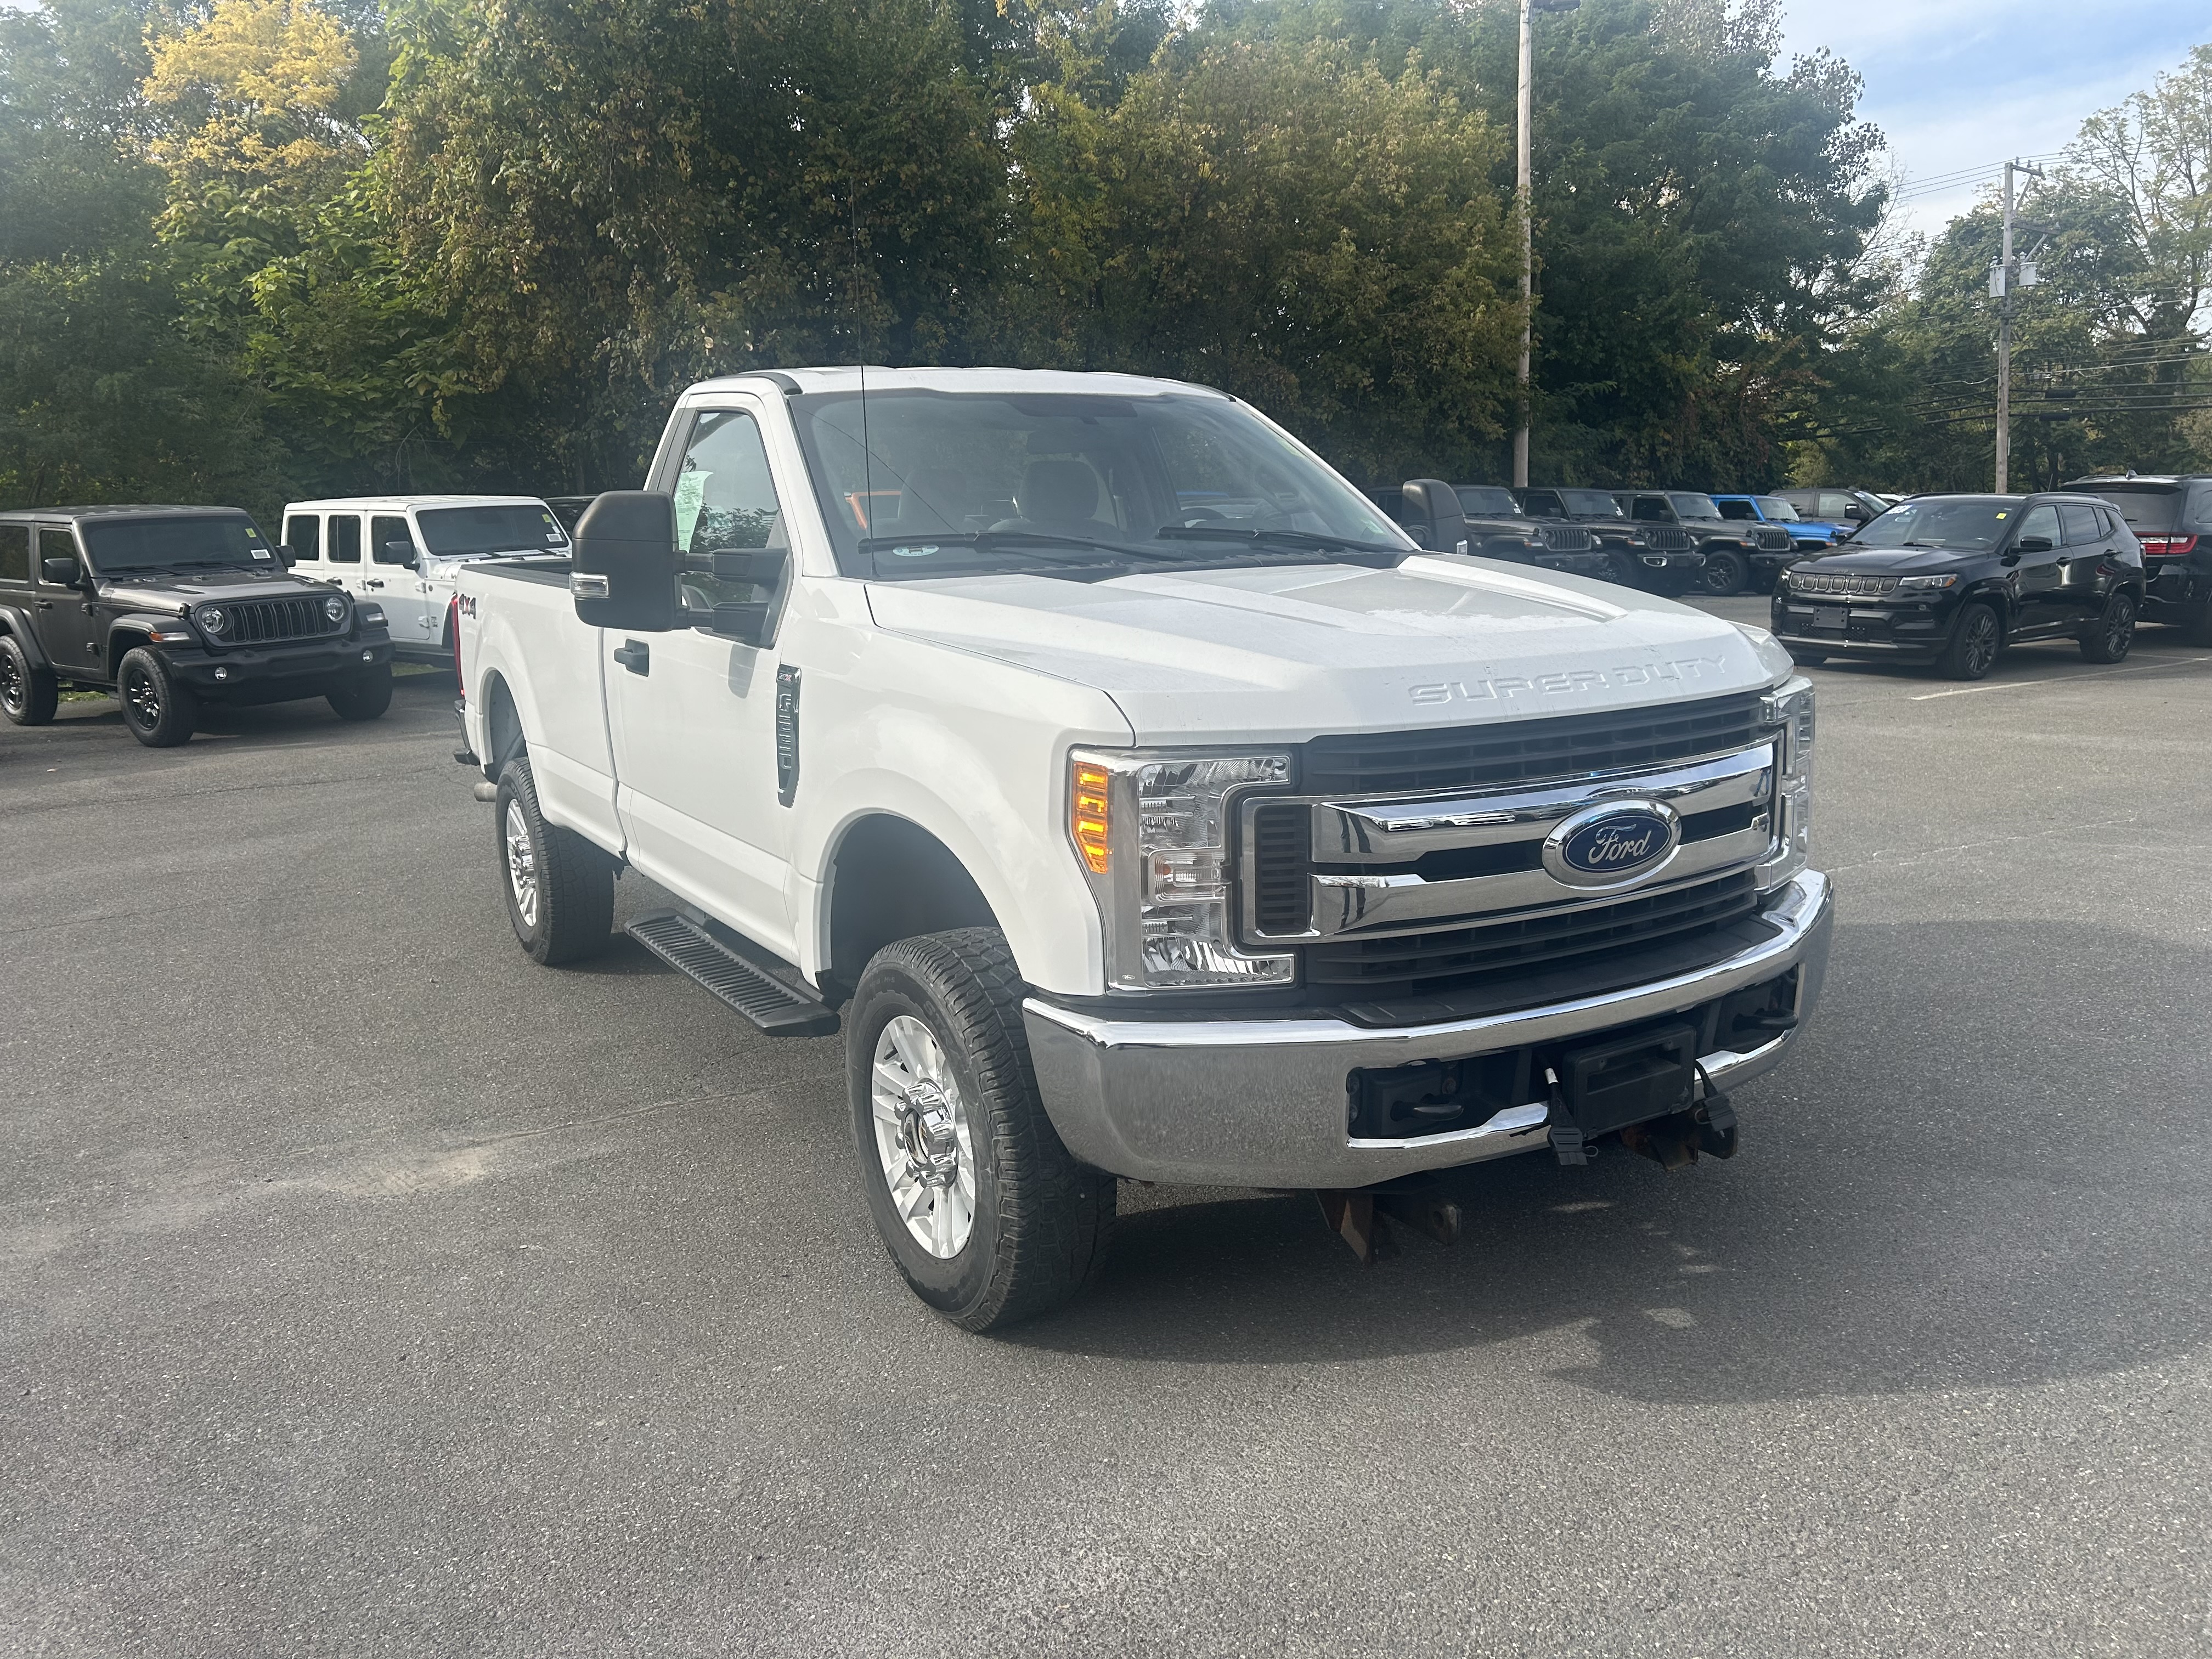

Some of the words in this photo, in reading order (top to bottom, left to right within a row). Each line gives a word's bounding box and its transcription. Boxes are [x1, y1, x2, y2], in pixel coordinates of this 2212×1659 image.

[1408, 669, 1610, 706] SUPER
[1611, 655, 1725, 687] DUTY
[1588, 823, 1652, 864] Ford
